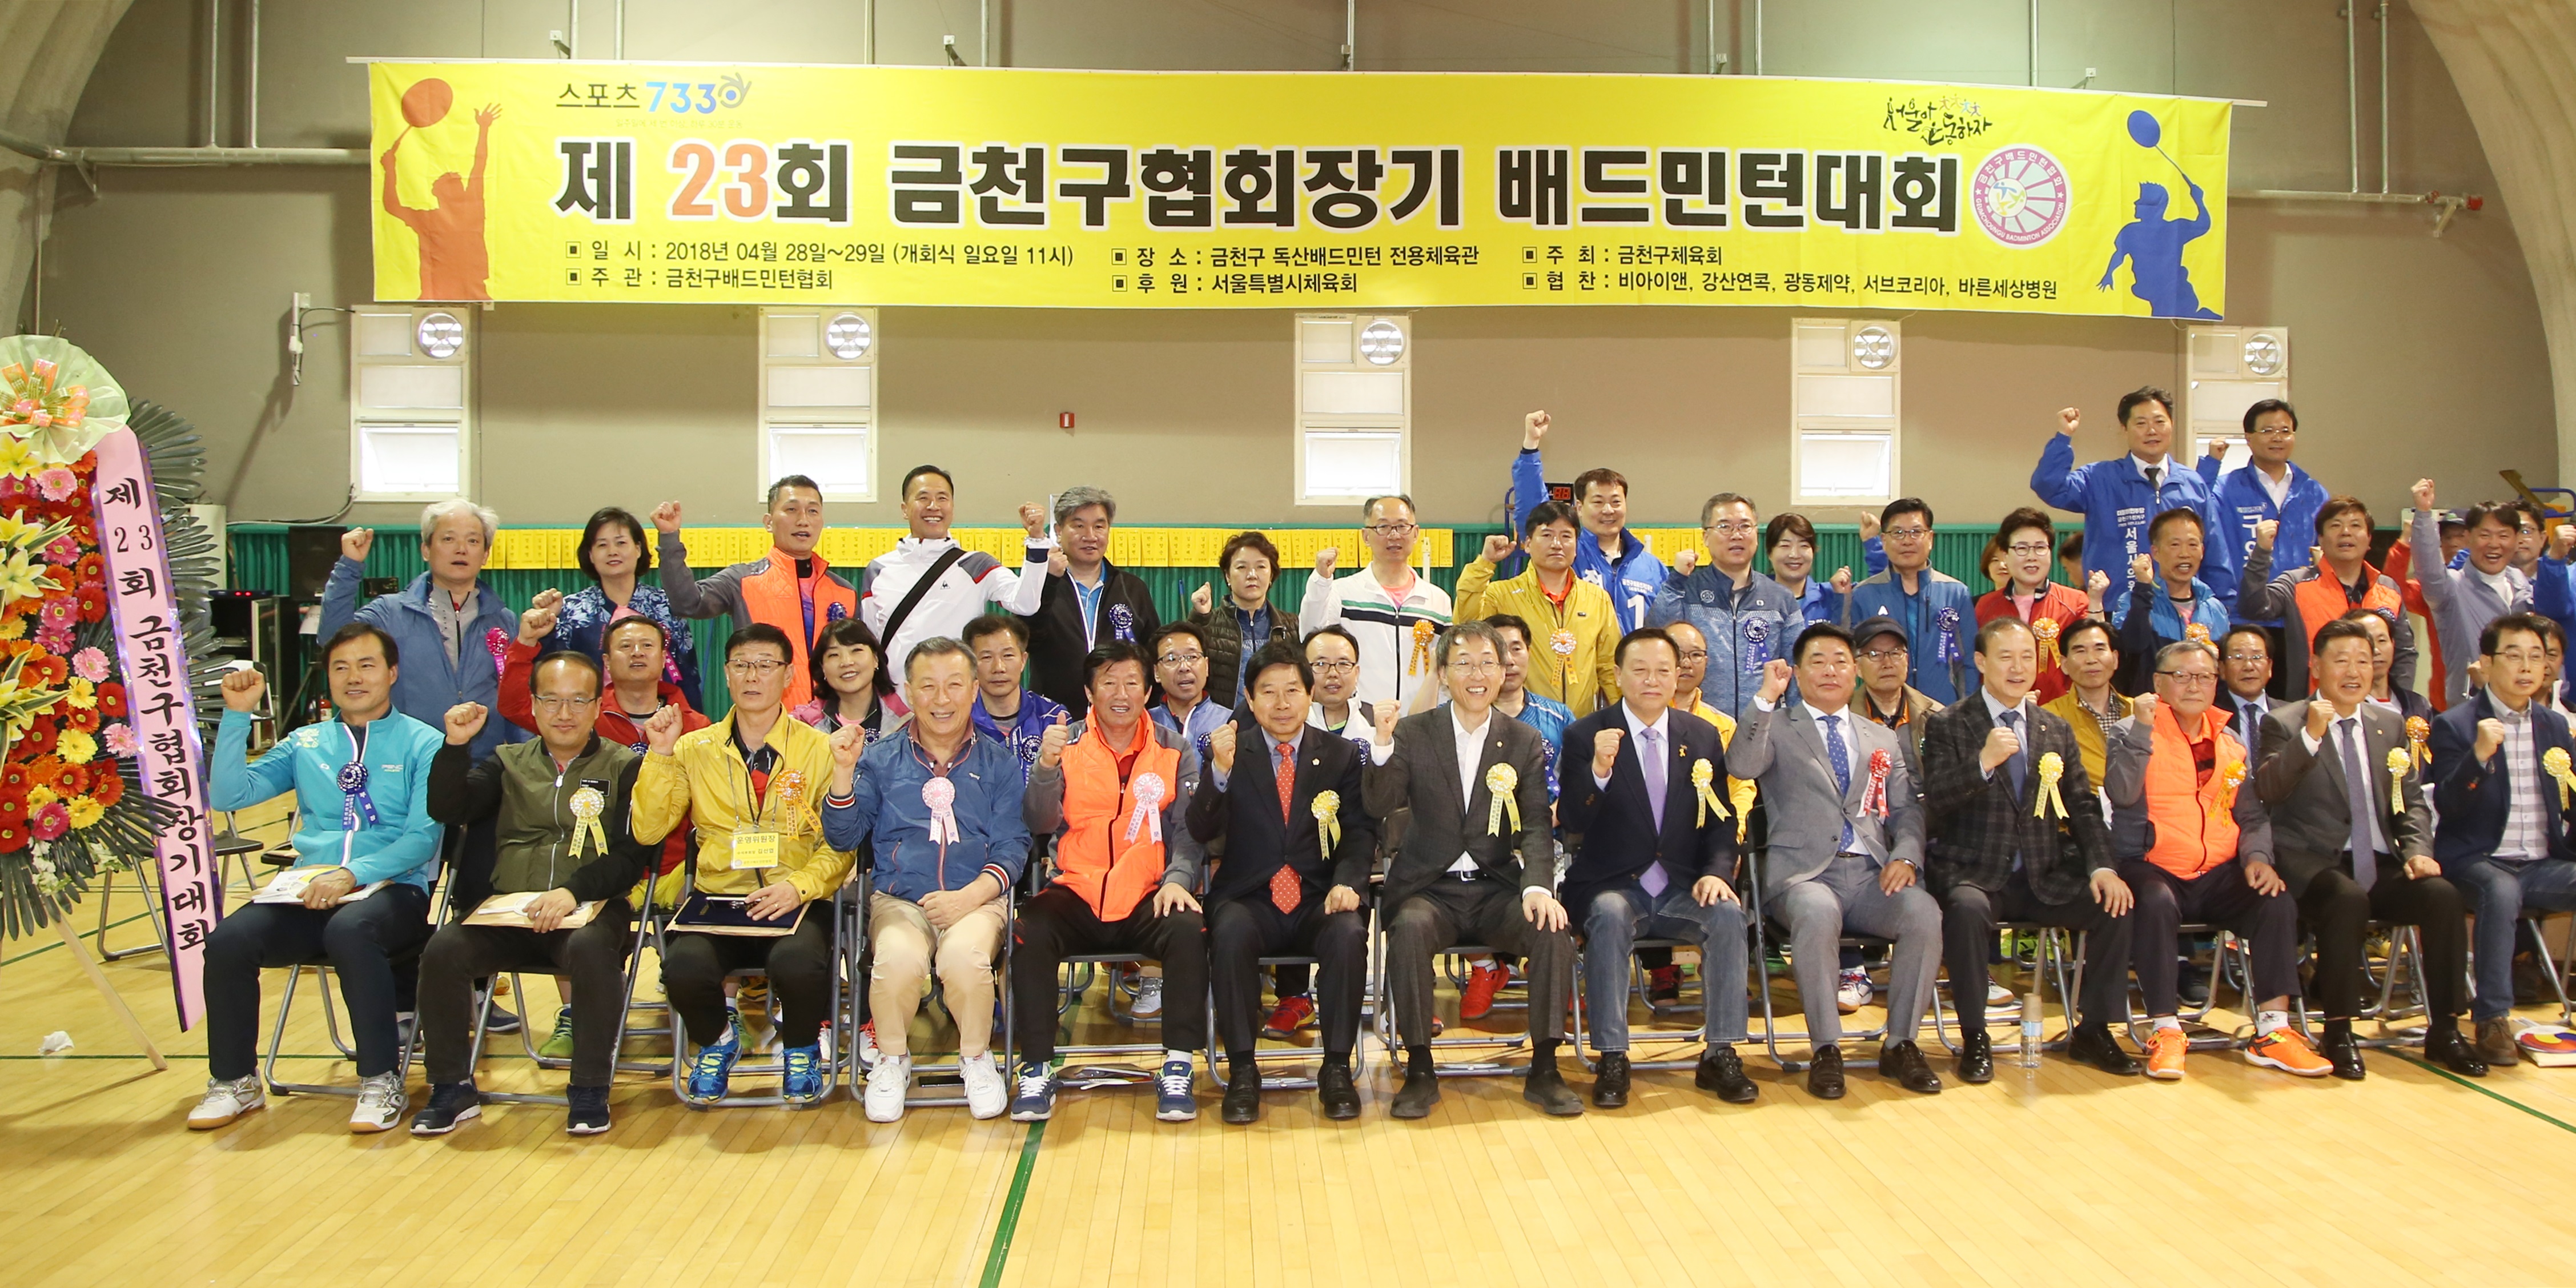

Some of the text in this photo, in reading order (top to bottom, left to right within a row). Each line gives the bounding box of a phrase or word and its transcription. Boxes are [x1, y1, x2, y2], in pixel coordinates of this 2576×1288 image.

[556, 83, 640, 108] 스포츠
[556, 142, 1958, 232] 제 23회 금천구협회장기 배드민턴대회
[2006, 232, 2041, 242] BADMINTON
[2040, 202, 2065, 236] ASSOCIATION
[666, 242, 728, 261] 2018년
[737, 242, 777, 262] 04월
[894, 244, 954, 264] (개회식
[964, 245, 1017, 265] 일요일
[1027, 246, 1074, 266] 11시)
[1211, 247, 1265, 267] 금천구
[1272, 246, 1381, 267] 독산배드민턴
[1390, 245, 1480, 266] 전용체육관
[1618, 245, 1722, 266] 금천구체육회
[666, 268, 832, 289] 금천구배드민턴협회
[1212, 272, 1357, 294] 서울특별시체육회
[1619, 271, 1694, 294] 비아이앤,
[1702, 272, 1777, 294] 강산연콕,
[1784, 272, 1855, 295] 광동제약,
[1863, 274, 1950, 298] 서브코리아,
[1959, 278, 2057, 300] 바른세상병원
[1627, 594, 1645, 630] 1
[737, 835, 775, 844] 운영위원장
